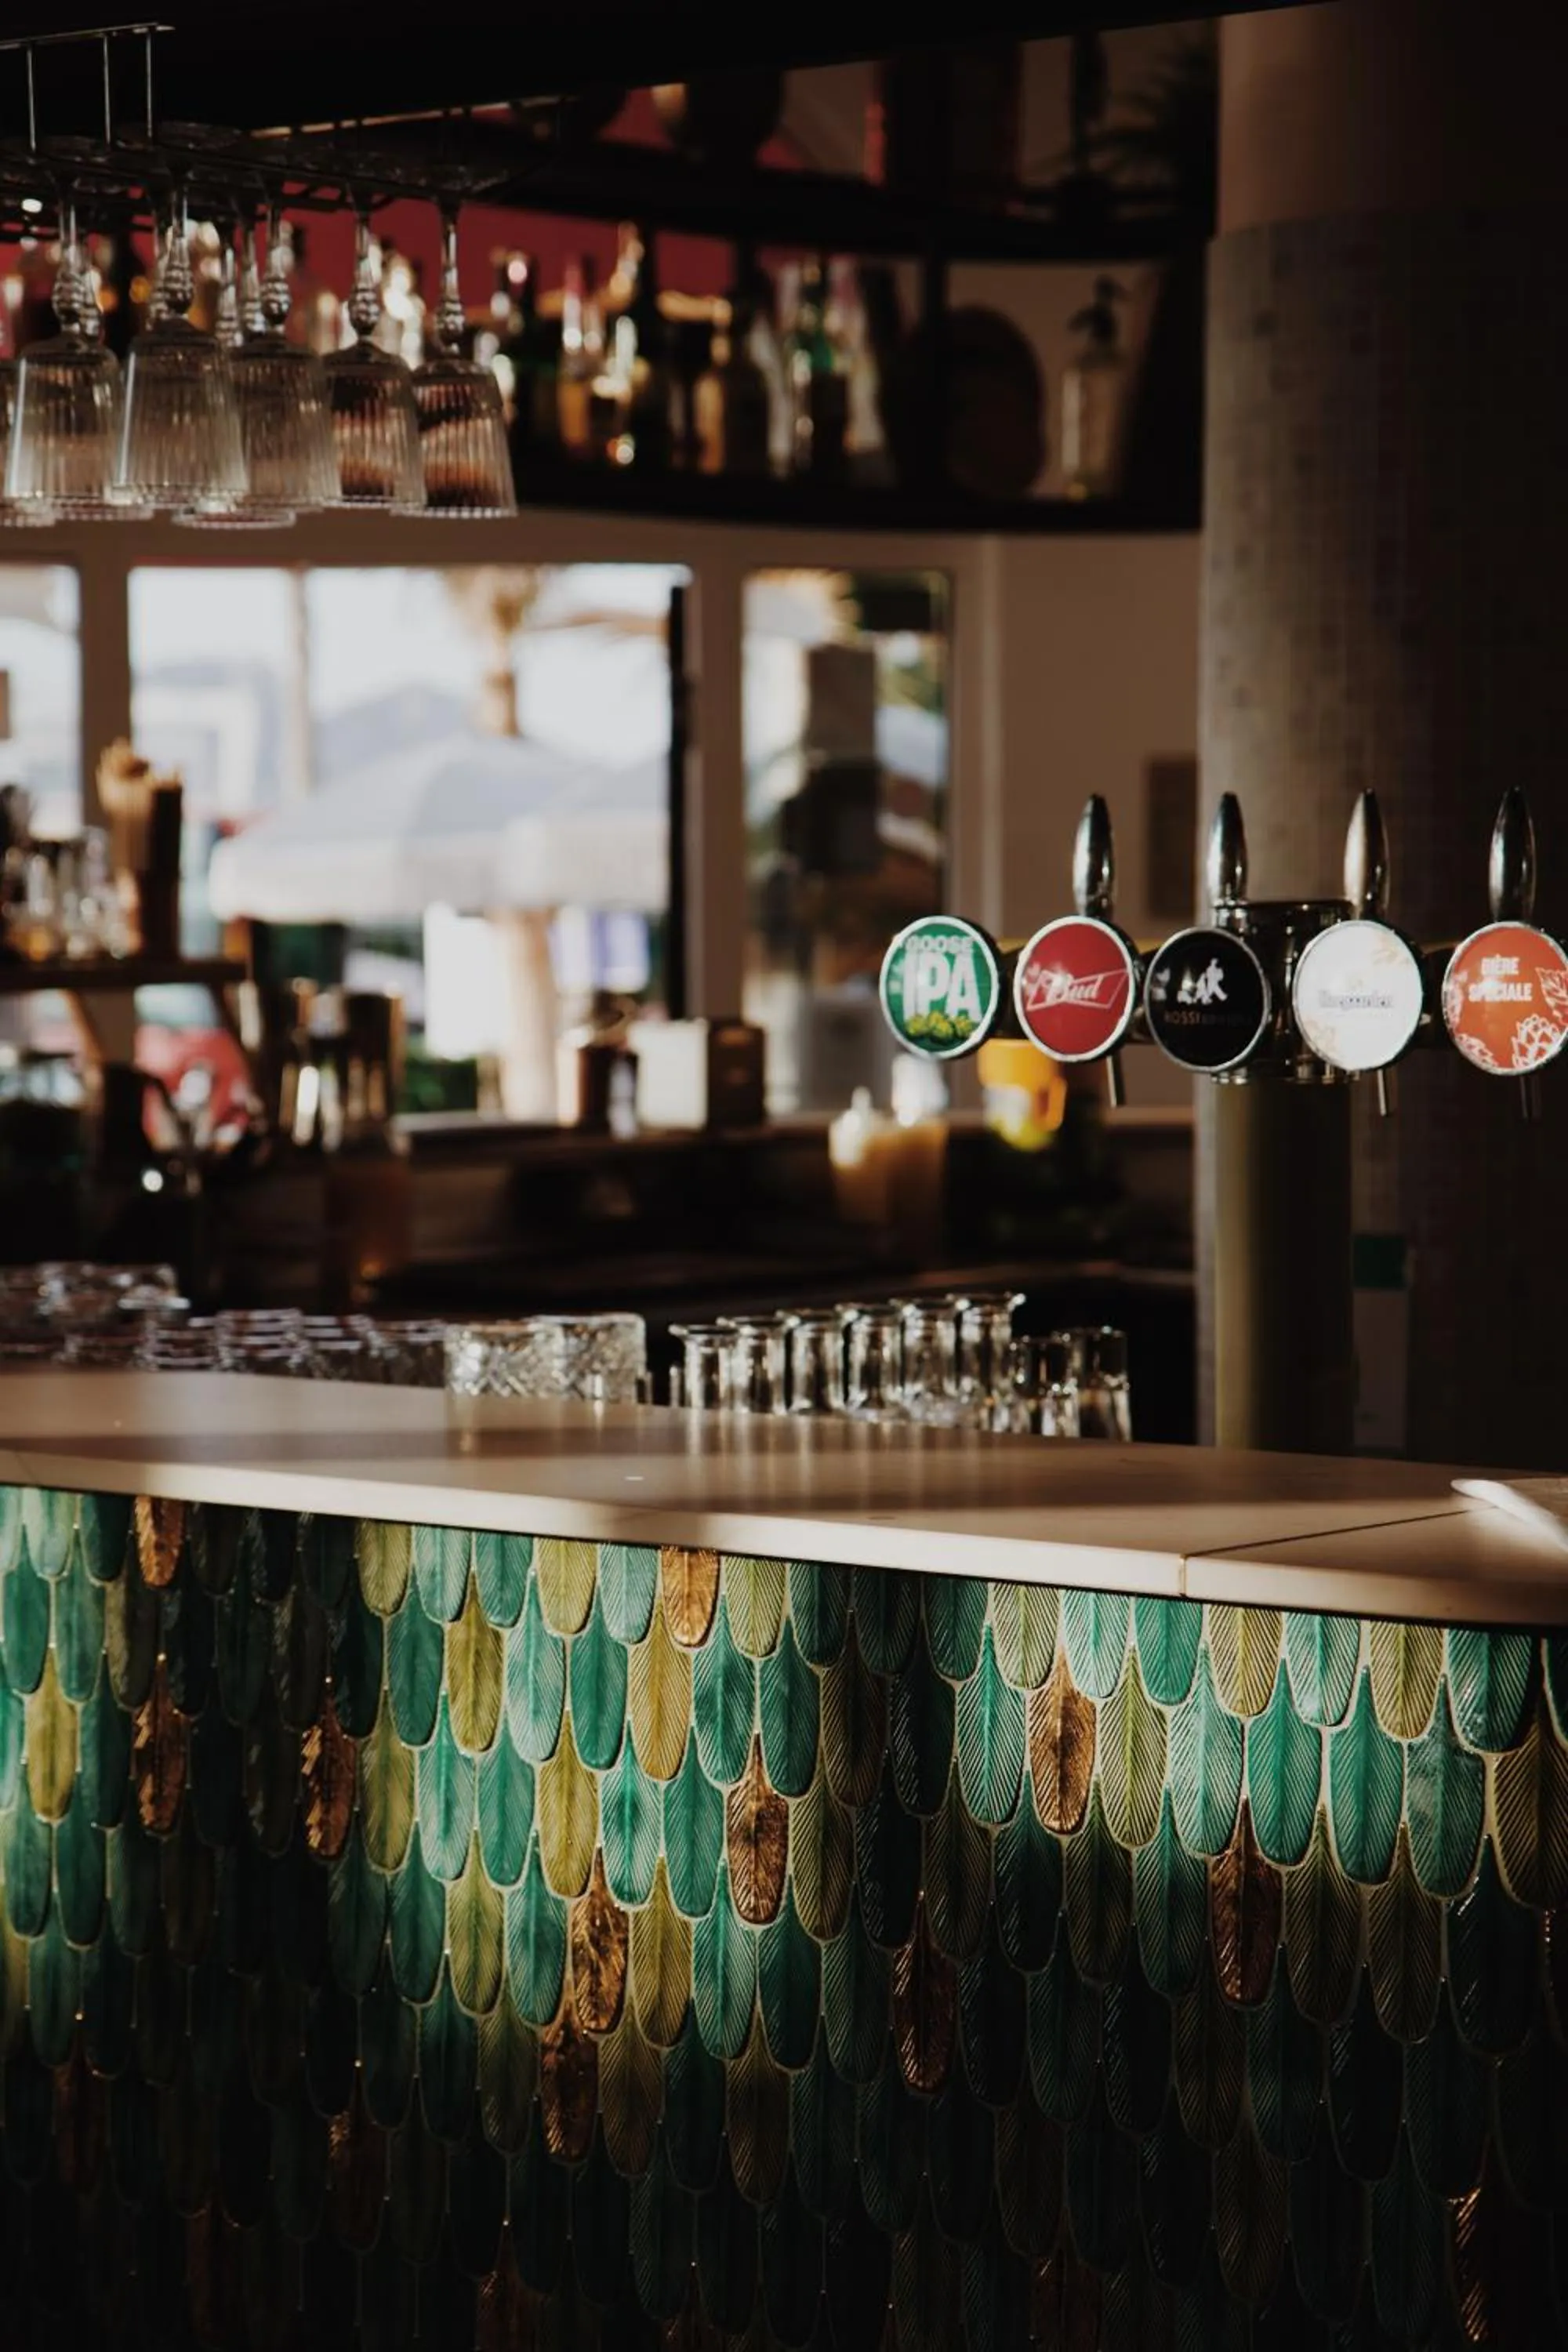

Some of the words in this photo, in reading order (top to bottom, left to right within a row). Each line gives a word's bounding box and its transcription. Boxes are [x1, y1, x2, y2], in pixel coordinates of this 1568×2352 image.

[906, 935, 975, 954] GOOSE
[902, 952, 982, 1022] IPA
[1045, 973, 1105, 1004] Bud
